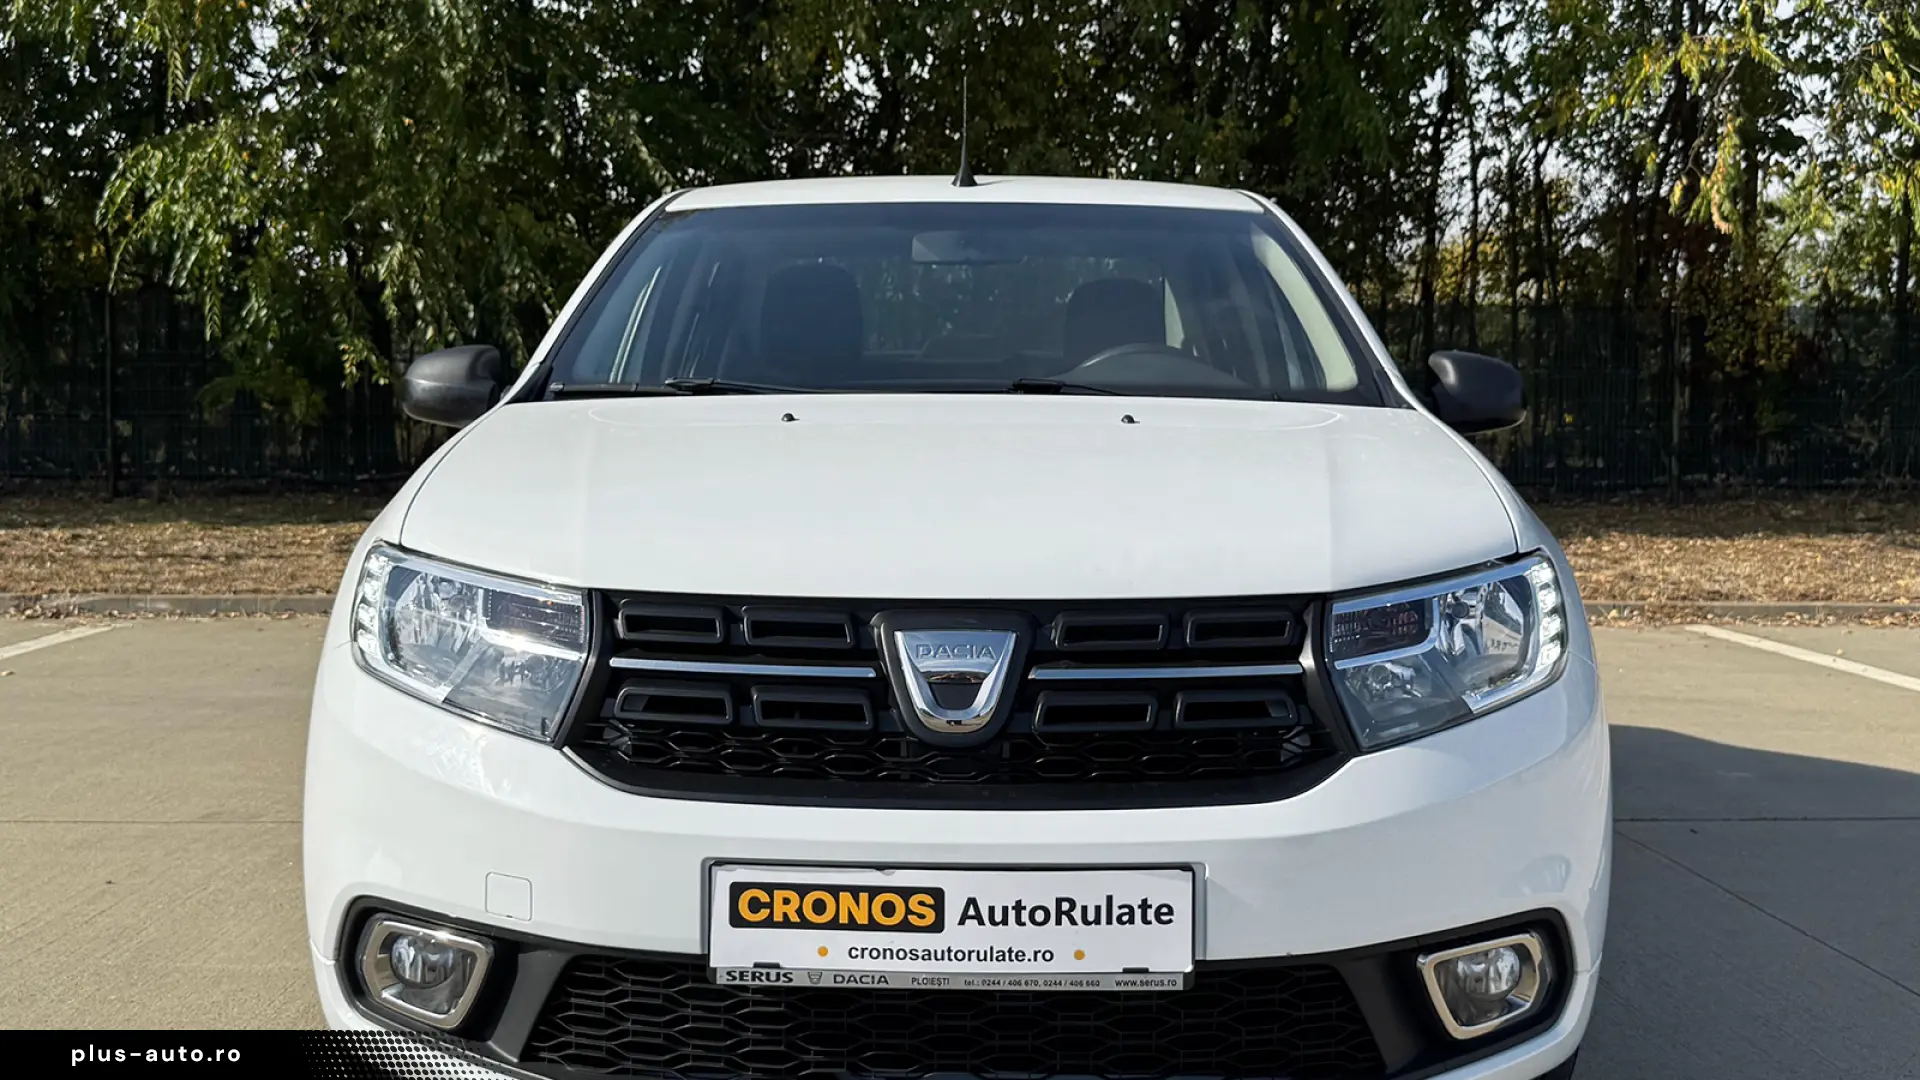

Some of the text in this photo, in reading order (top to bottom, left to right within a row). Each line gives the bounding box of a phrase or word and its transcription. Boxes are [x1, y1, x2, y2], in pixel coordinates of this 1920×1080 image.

[915, 643, 997, 659] DACIA
[738, 888, 1175, 927] CRONOS AutoRulate
[847, 944, 1054, 964] cronosautorulate.ro
[726, 970, 794, 983] SERUS
[833, 974, 889, 985] DACIA
[1115, 978, 1177, 987] www.serus.ro
